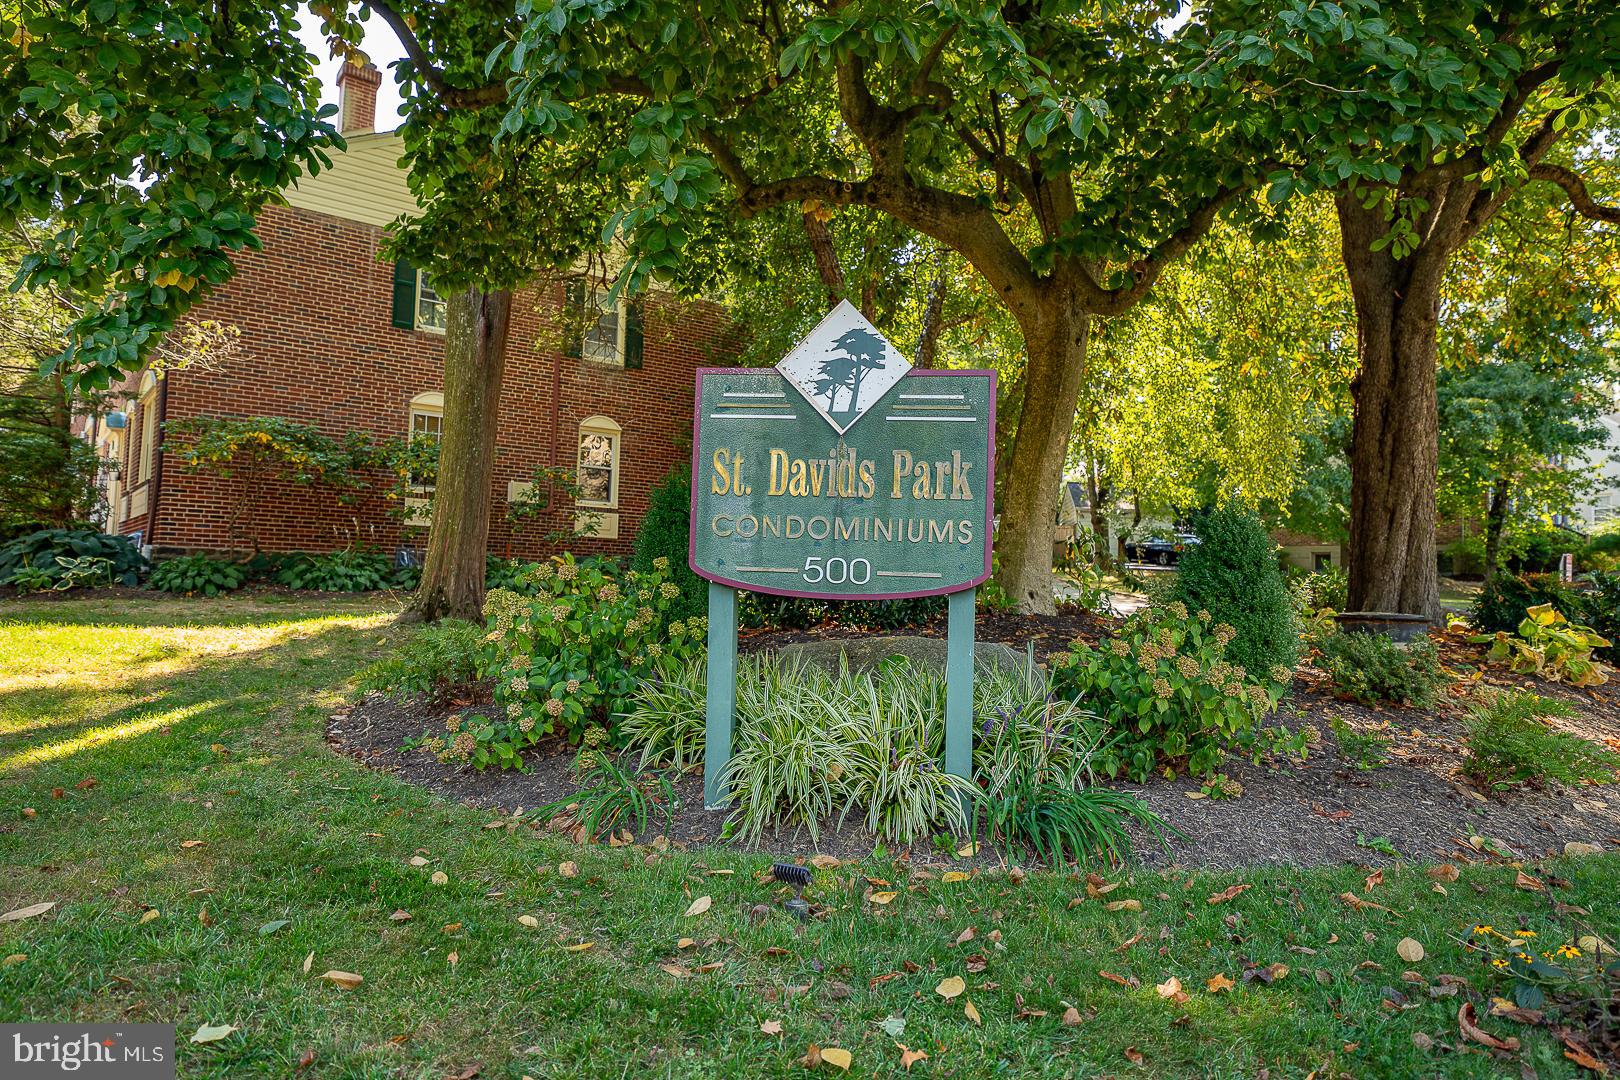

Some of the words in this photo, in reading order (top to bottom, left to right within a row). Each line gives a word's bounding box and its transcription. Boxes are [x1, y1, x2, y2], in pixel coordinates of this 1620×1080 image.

[711, 447, 751, 496] St.
[767, 448, 875, 499] Davids
[890, 449, 973, 500] Park
[711, 513, 974, 545] CONDOMINIUMS
[802, 556, 872, 585] 500
